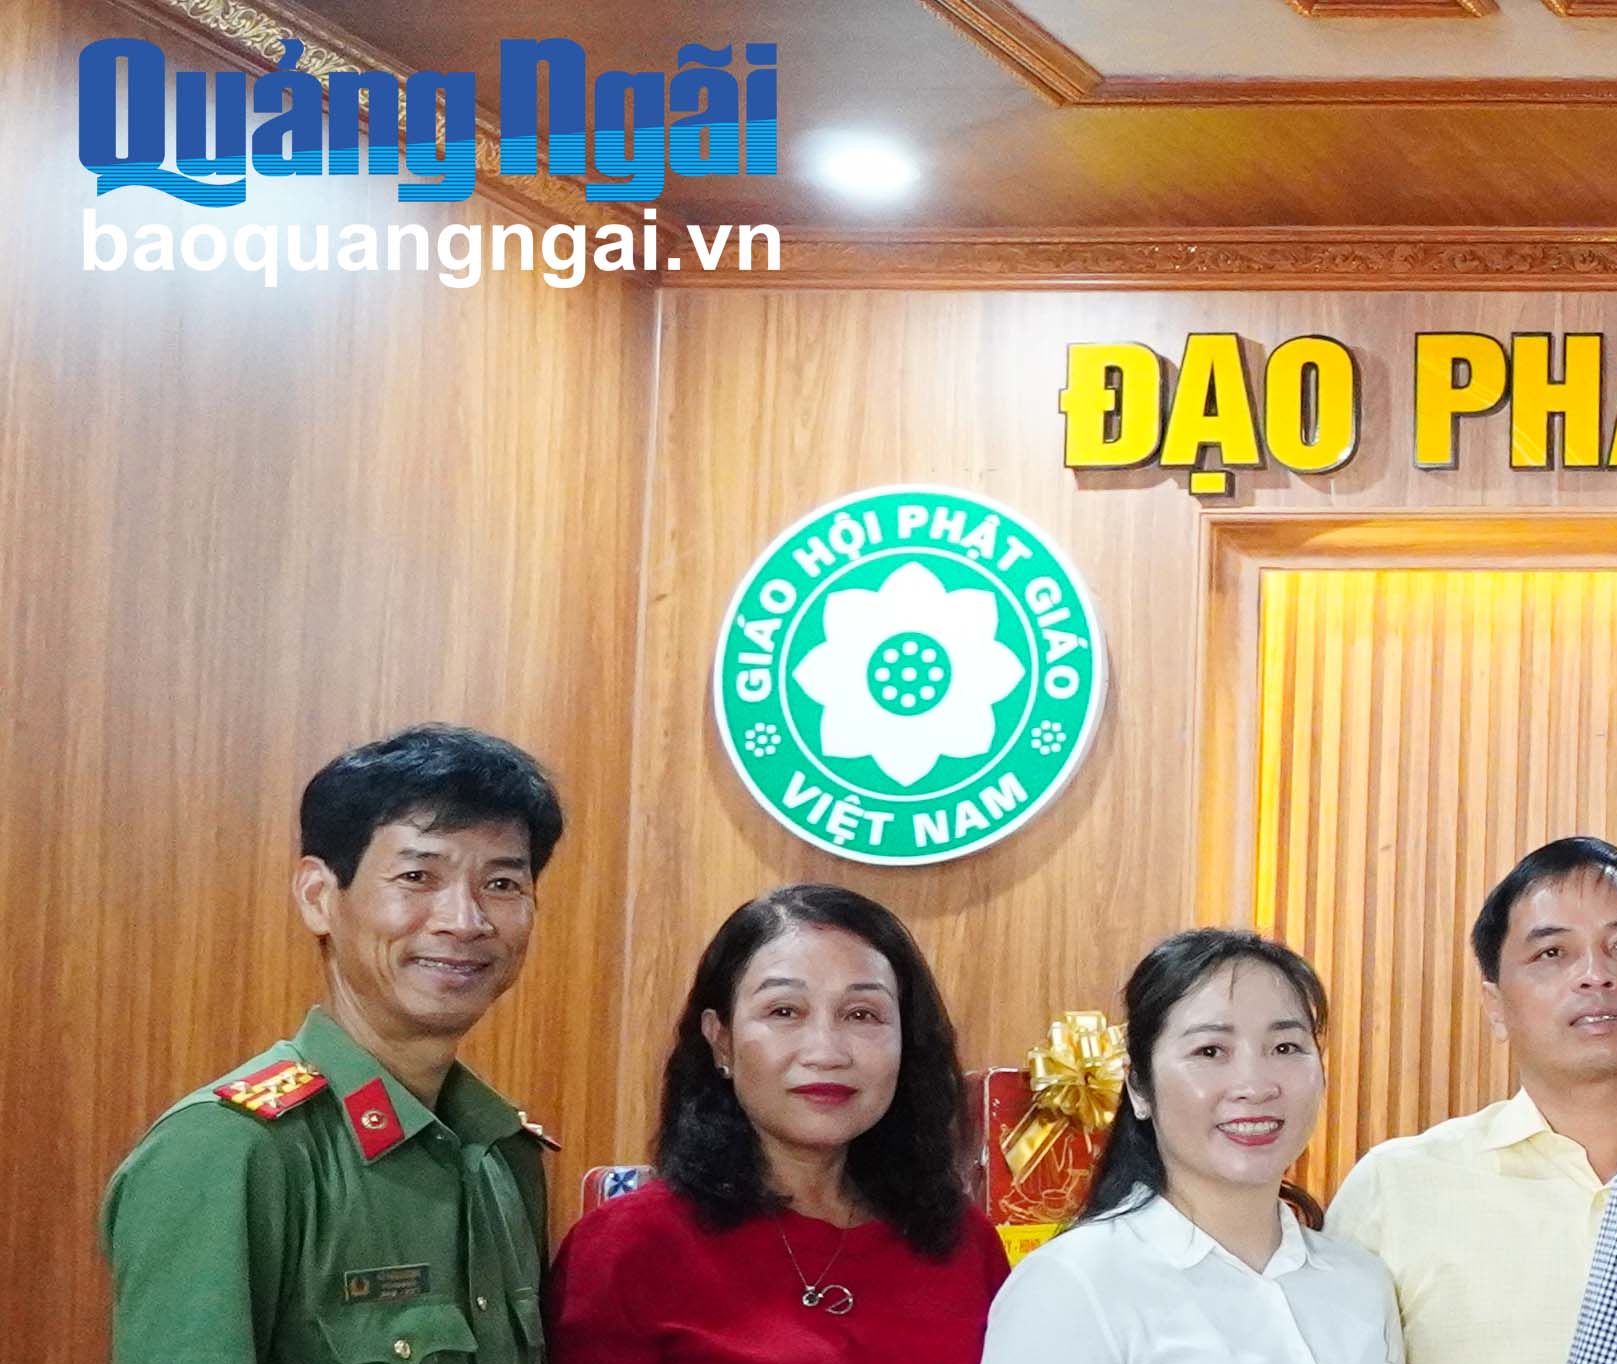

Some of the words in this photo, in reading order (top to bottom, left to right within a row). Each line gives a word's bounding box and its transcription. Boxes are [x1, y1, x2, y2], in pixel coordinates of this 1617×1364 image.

[1059, 332, 1362, 498] ĐẠO
[735, 578, 797, 703] GIÁO
[792, 510, 883, 578] HỘI
[897, 504, 1033, 571] PHẬT
[1024, 575, 1089, 699] GIÁO
[781, 770, 894, 846] VIỆT
[912, 771, 1029, 848] NAM
